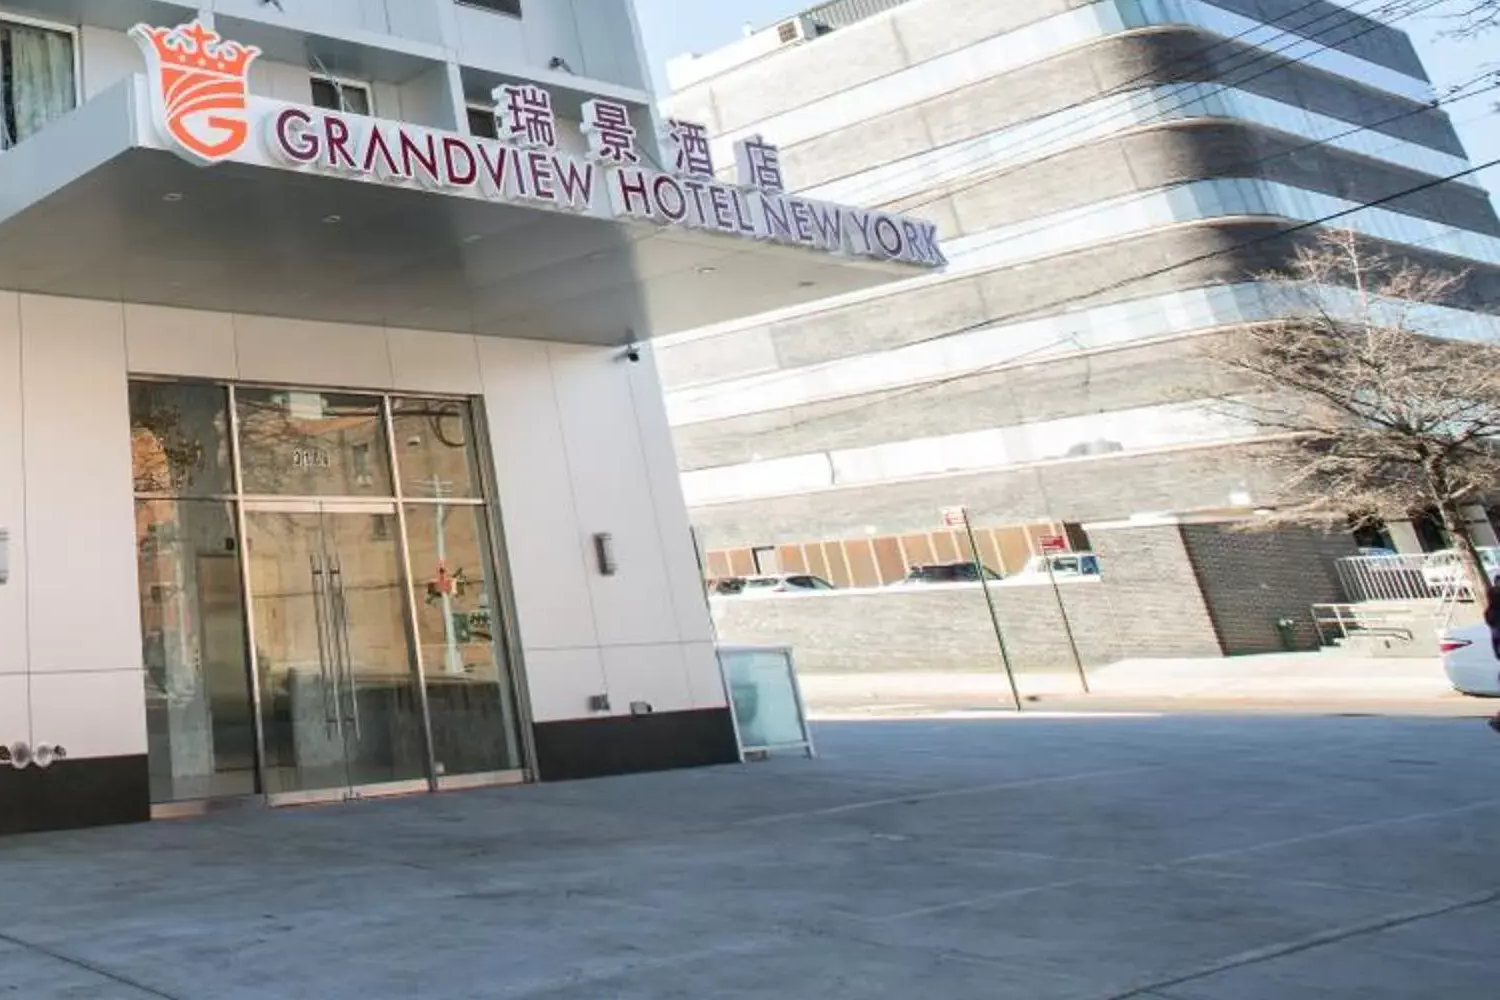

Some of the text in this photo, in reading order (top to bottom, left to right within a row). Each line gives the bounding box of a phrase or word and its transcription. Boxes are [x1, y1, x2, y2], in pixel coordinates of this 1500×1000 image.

[274, 107, 948, 266] GRANDVIEW HOTEL NEW YORK
[504, 86, 785, 195] 瑞景酒店
